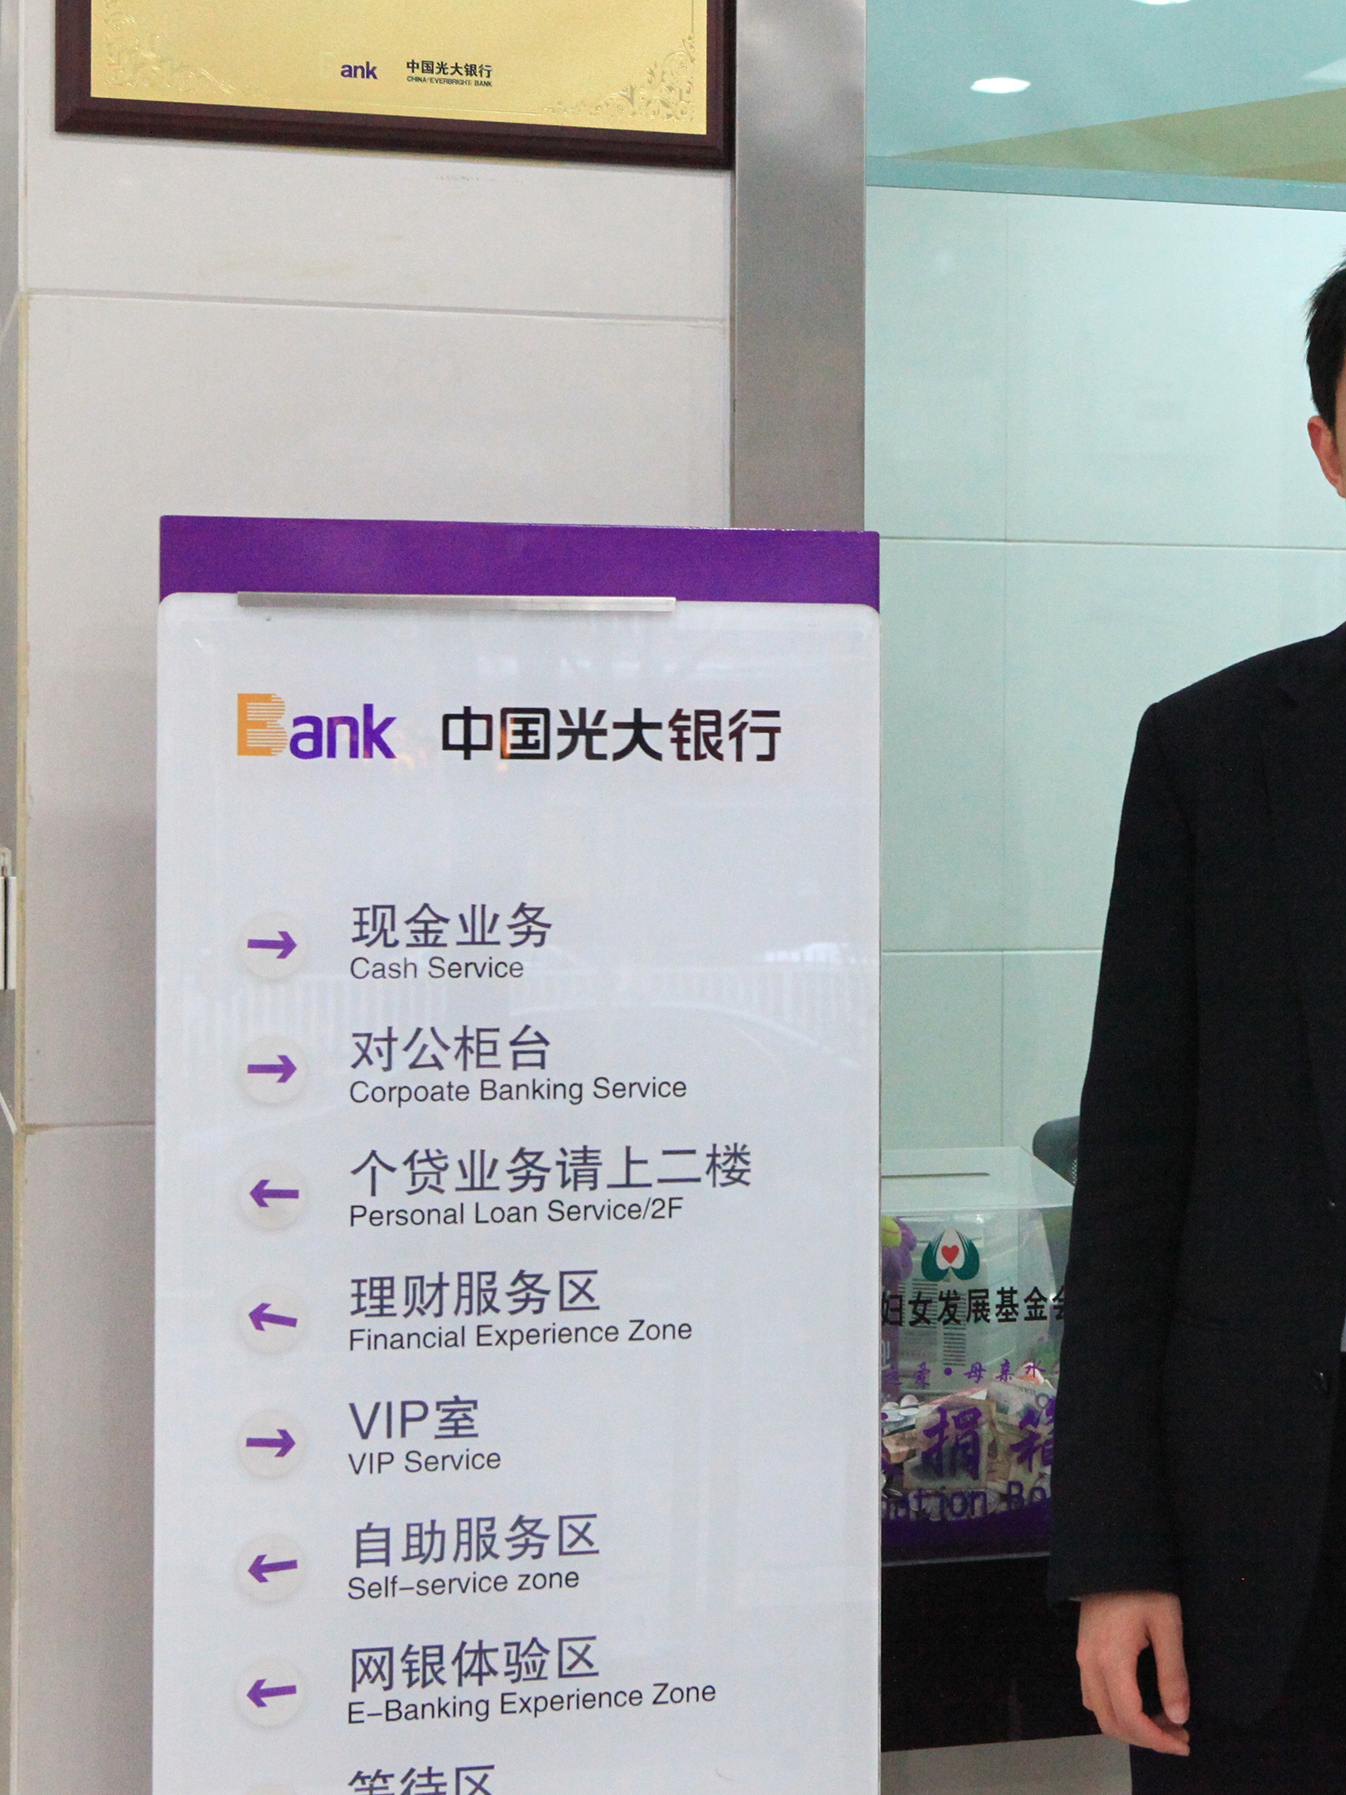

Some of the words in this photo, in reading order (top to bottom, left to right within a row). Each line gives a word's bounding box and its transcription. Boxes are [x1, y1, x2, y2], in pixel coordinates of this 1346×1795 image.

[406, 59, 492, 78] 中国光大银行
[406, 75, 428, 83] CHINA
[429, 77, 472, 86] EVERBRIGHT
[474, 79, 493, 88] BANK
[238, 694, 396, 759] Bank
[442, 706, 781, 762] 中国光大银行
[352, 902, 552, 948] 现金业务
[351, 957, 418, 979] Cash
[429, 956, 524, 979] Service
[351, 1024, 550, 1072] 对公柜台
[350, 1081, 470, 1109] Corpoate
[481, 1078, 583, 1105] Banking
[593, 1077, 687, 1100] Service
[351, 1143, 750, 1197] 个贷业务请上二楼
[351, 1203, 464, 1228] Personal
[475, 1202, 537, 1224] Loan
[548, 1197, 684, 1223] Service/2F
[351, 1269, 600, 1318] 理财服务区
[350, 1326, 466, 1352] Financial
[477, 1323, 619, 1351] Experience
[628, 1320, 693, 1342] Zone
[349, 1395, 479, 1440] VIP室
[881, 1398, 1056, 1481] 捐箱
[349, 1452, 395, 1476] VIP
[405, 1448, 501, 1474] Service
[356, 1514, 600, 1569] 自助服务区
[348, 1572, 509, 1601] Self-service
[518, 1571, 580, 1591] zone
[352, 1636, 599, 1692] 网银体验区
[349, 1699, 490, 1725] E-Banking
[501, 1689, 643, 1719] Experience
[653, 1683, 716, 1706] Zone
